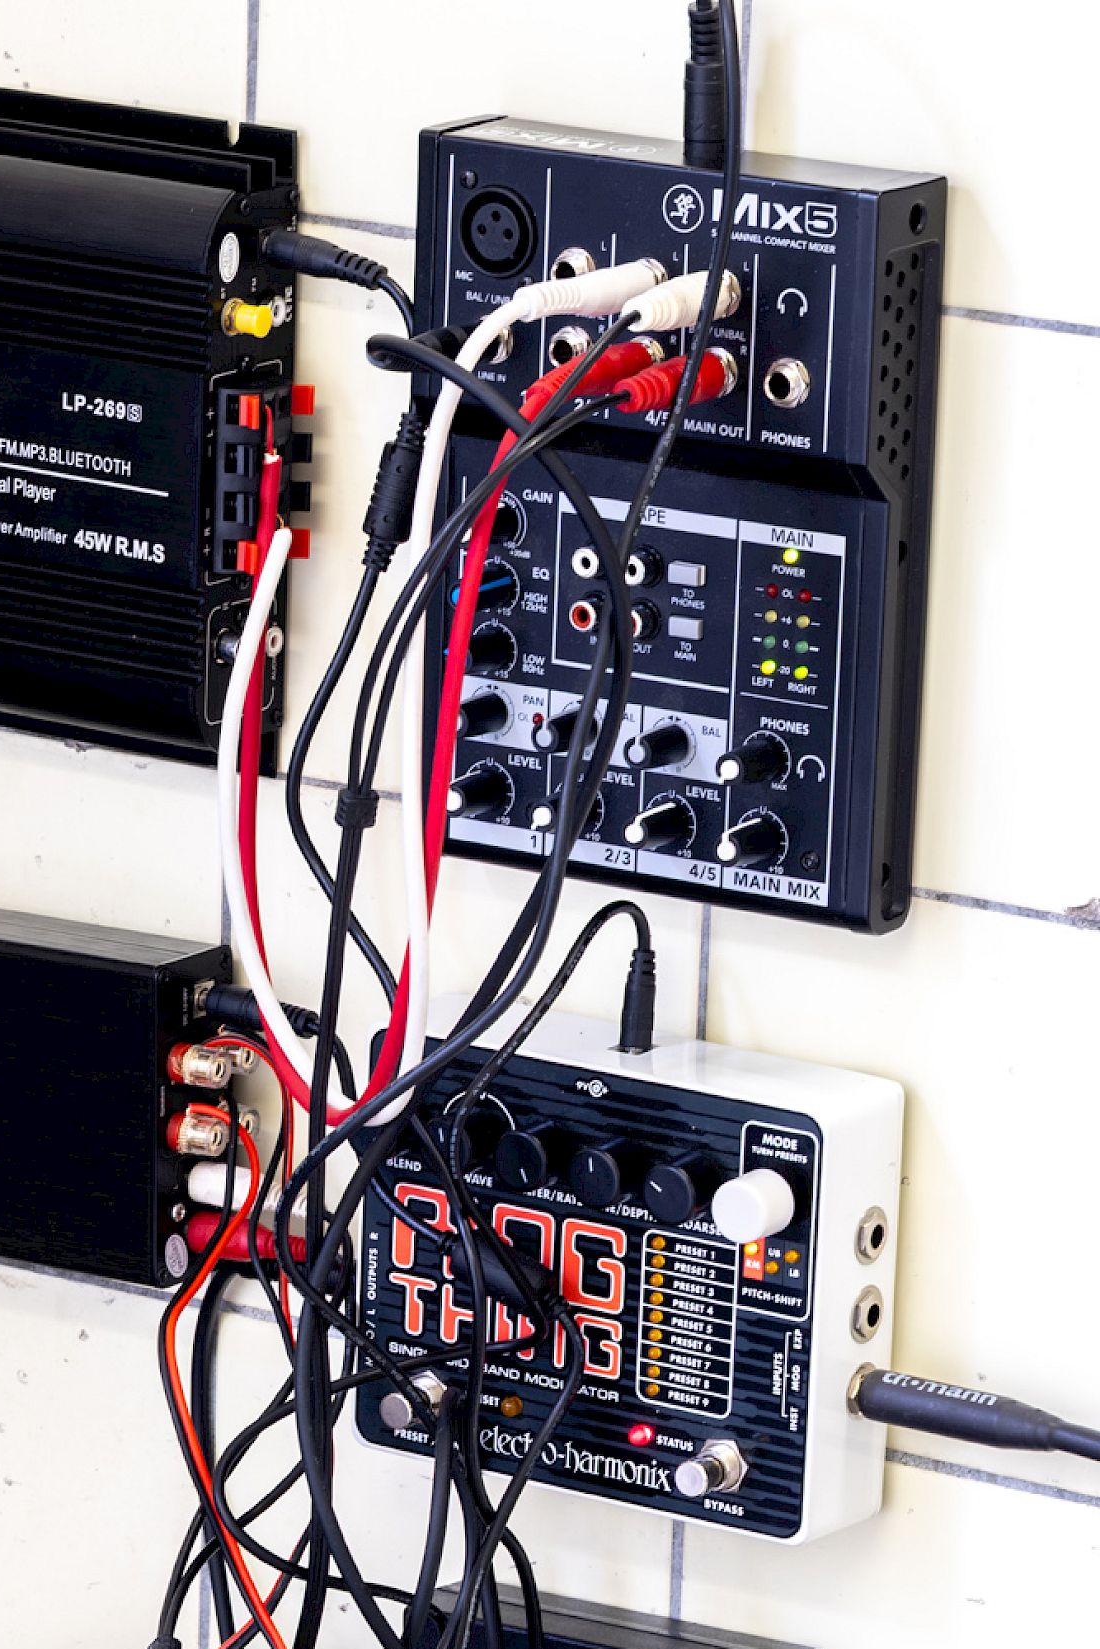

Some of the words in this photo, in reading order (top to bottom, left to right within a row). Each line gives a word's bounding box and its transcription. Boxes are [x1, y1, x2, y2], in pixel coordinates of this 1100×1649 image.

[764, 236, 807, 251] COMPACT
[808, 242, 836, 254] MIXER
[454, 270, 474, 282] MIC
[477, 370, 496, 381] LINE
[497, 373, 507, 383] IN
[683, 418, 717, 434] MAIN
[720, 424, 745, 439] OUT
[761, 430, 811, 449] PHONES
[12, 476, 57, 502] Player
[522, 489, 553, 504] GAIN
[641, 507, 667, 525] PE
[14, 522, 69, 545] Amplifier
[73, 529, 112, 553] 45W
[114, 535, 166, 564] R.M.S
[771, 527, 814, 548] MAIN
[532, 566, 550, 581] EQ
[771, 564, 806, 578] POWER
[524, 591, 549, 604] HIGH
[683, 588, 695, 599] TO
[670, 597, 705, 610] PHONES
[680, 641, 692, 651] TO
[522, 653, 545, 665] LOW
[674, 650, 697, 662] MAIN
[752, 676, 775, 688] LEFT
[787, 682, 818, 696] RIGHT
[522, 694, 545, 707] PAN
[701, 725, 721, 738] BAL
[760, 716, 810, 735] PHONES
[507, 754, 542, 771] LEVEL
[685, 784, 721, 802] LEVEL
[531, 836, 537, 848] 1
[604, 848, 631, 865] 2/3
[688, 864, 717, 881] 4/5
[733, 871, 781, 893] MAIN
[787, 881, 821, 901] MIX
[761, 1132, 798, 1151] MODE
[774, 1149, 808, 1164] PRESETS
[675, 1244, 707, 1259] PRESET
[367, 1248, 379, 1300] OUTPUTS
[674, 1262, 707, 1277] PRESET
[673, 1280, 706, 1295] PRESET
[672, 1299, 705, 1314] PRESET
[671, 1316, 704, 1332] PRESET
[670, 1335, 703, 1350] PRESET
[669, 1353, 702, 1369] PRESET
[668, 1371, 701, 1387] PRESET
[772, 1352, 783, 1395] INPUTS
[790, 1365, 801, 1392] MOD
[523, 1371, 620, 1404] MODATOR
[667, 1390, 701, 1406] PRESET
[789, 1406, 799, 1432] INST
[656, 1434, 694, 1452] STATUS
[480, 1425, 672, 1493] electo-harmonix
[703, 1498, 745, 1517] BYPASS
